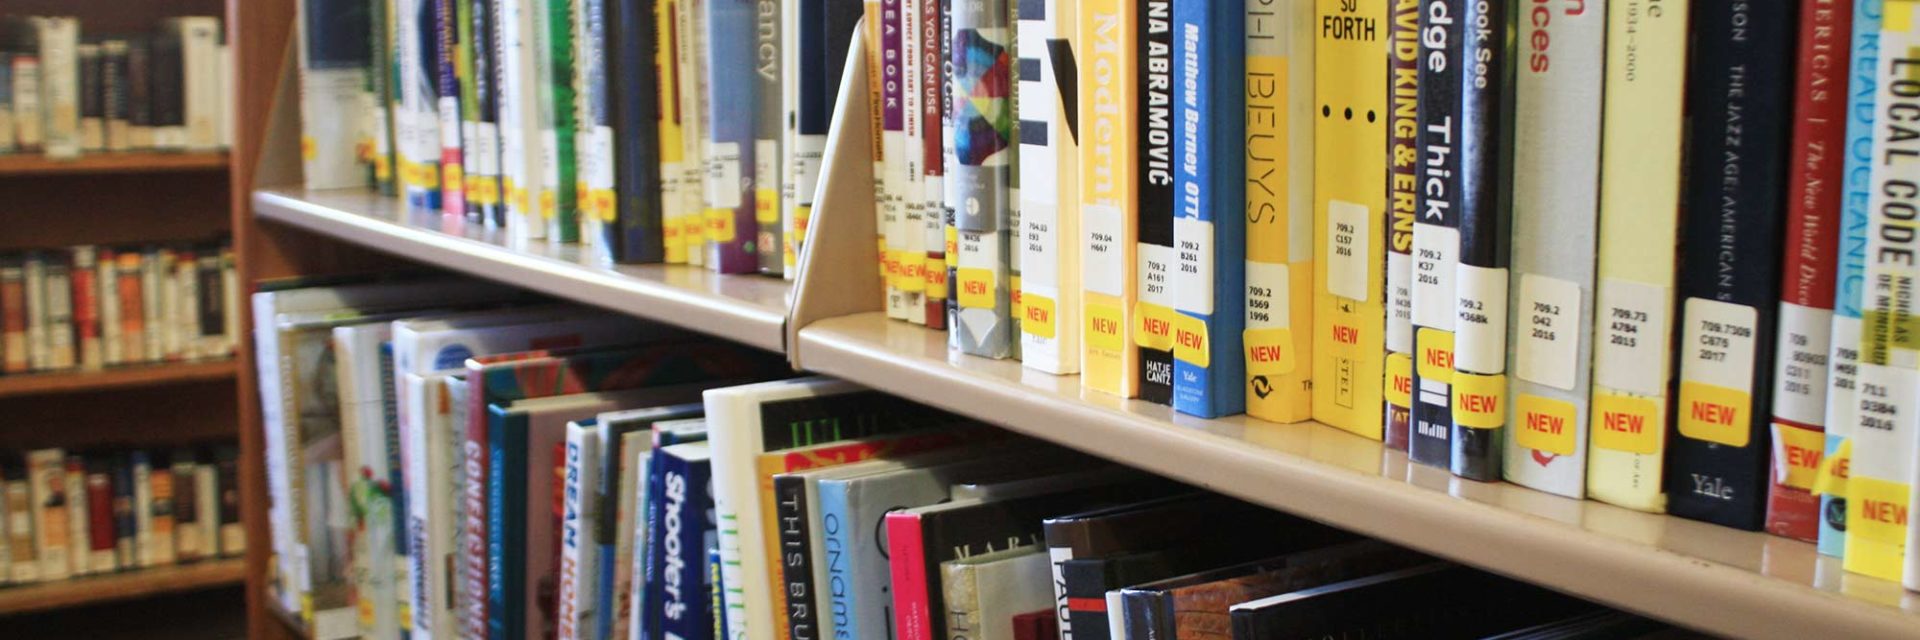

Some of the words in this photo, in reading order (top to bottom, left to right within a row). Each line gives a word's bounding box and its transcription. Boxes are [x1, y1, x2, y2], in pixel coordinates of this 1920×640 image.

[1149, 2, 1168, 33] NA
[1248, 0, 1274, 39] H
[1323, 16, 1376, 41] FORTH
[1476, 0, 1492, 41] ook
[757, 0, 777, 82] ancy
[925, 18, 935, 49] YOU
[944, 6, 952, 53] Juan
[1423, 1, 1453, 73] dge
[926, 52, 936, 84] CAN
[1185, 23, 1199, 108] Matthew
[1474, 48, 1492, 89] See
[886, 49, 896, 109] BOOK
[1728, 65, 1744, 97] THE
[1855, 33, 1880, 125] READ
[926, 87, 937, 114] USE
[1094, 12, 1118, 193] Modern
[1394, 68, 1418, 138] KING
[1883, 58, 1920, 166] LOCAL
[1149, 41, 1173, 186] ABRAMOVIĆ
[1726, 104, 1742, 146] JAZZ
[1184, 108, 1199, 176] Barney
[1248, 73, 1275, 224] BEUYS
[1394, 144, 1416, 167] &
[1806, 141, 1825, 170] The
[1426, 116, 1451, 220] Thick
[1804, 173, 1823, 208] New
[1393, 174, 1417, 251] ERNS
[1843, 136, 1874, 295] OCEANIC
[1877, 179, 1919, 267] CODE
[1091, 232, 1112, 242] 709.04
[1336, 222, 1354, 234] 709.2
[1336, 234, 1352, 245] C157
[1801, 214, 1820, 261] World
[1181, 241, 1199, 251] 709.2
[1336, 246, 1352, 257] 2016
[1718, 196, 1736, 287] AMERICAN
[1181, 252, 1197, 261] B261
[1419, 248, 1442, 261] 709.2
[1147, 272, 1164, 282] A161
[1148, 261, 1166, 272] 709.2
[1181, 263, 1197, 274] 2016
[1418, 261, 1434, 272] K37
[964, 280, 986, 295] NEW
[1147, 284, 1163, 293] 2017
[1418, 273, 1438, 286] 2016
[1011, 289, 1021, 304] NE
[1249, 286, 1271, 298] 709.2
[1027, 306, 1048, 323] NEW
[1250, 311, 1269, 322] 1996
[1459, 299, 1483, 311] 709.2
[1533, 302, 1560, 316] 709.2
[1611, 307, 1647, 323] 709.73
[1093, 317, 1117, 335] NEW
[1144, 317, 1169, 336] NEW
[1333, 325, 1358, 344] NEW
[1532, 328, 1555, 341] 2016
[1176, 329, 1202, 350] NEW
[1610, 334, 1636, 348] 2015
[1250, 345, 1281, 362] NEW
[1699, 348, 1726, 363] 2017
[1147, 360, 1171, 373] HATJE
[1147, 371, 1171, 386] CANTZ
[1394, 374, 1410, 394] NE
[1784, 381, 1809, 395] 2015
[1862, 382, 1888, 398] 711
[1460, 393, 1497, 414] NEW
[1691, 401, 1736, 426] NEW
[1391, 409, 1409, 422] TAT
[1526, 412, 1564, 435] NEW
[1603, 411, 1644, 434] NEW
[1860, 414, 1895, 431] 2016
[1786, 444, 1823, 470] EW
[565, 442, 579, 548] DREAM
[1691, 473, 1735, 500] Yale
[1862, 499, 1908, 527] NEW
[466, 440, 489, 640] CONFECTIONE
[783, 495, 802, 567] THIS
[664, 471, 687, 620] Shooter's
[790, 582, 811, 640] BRU
